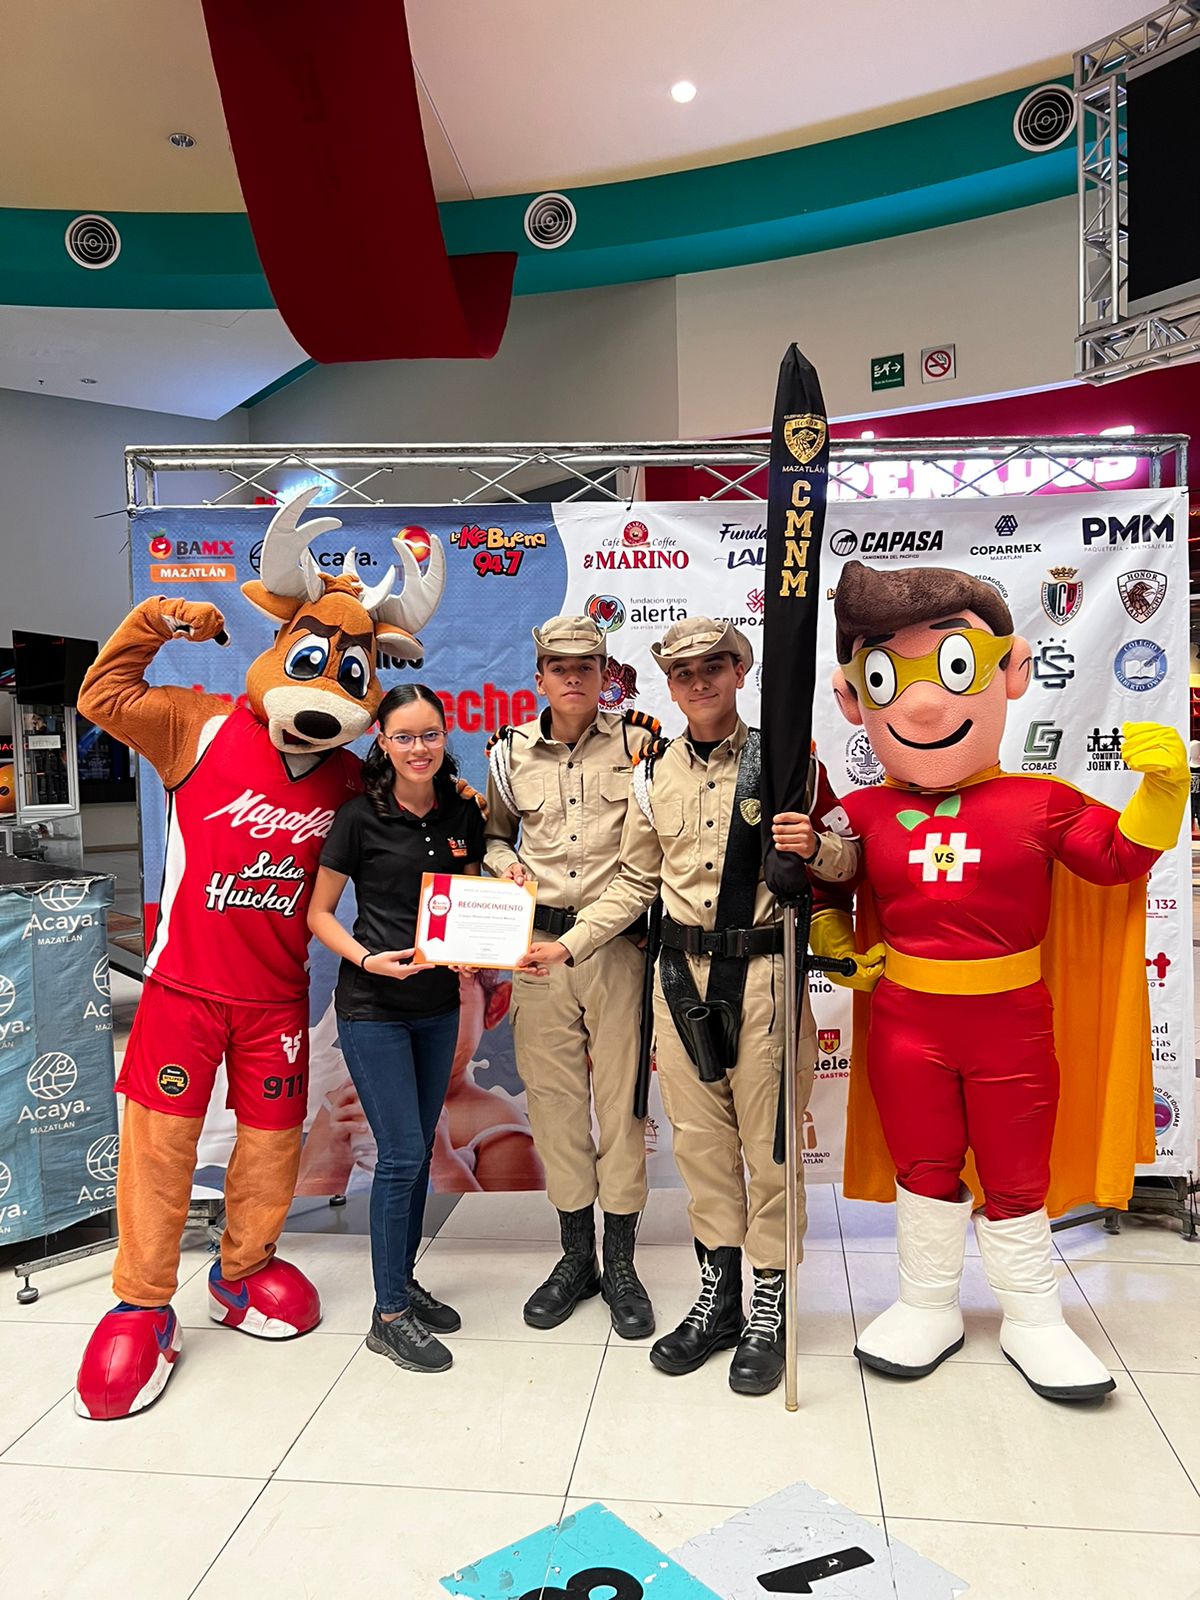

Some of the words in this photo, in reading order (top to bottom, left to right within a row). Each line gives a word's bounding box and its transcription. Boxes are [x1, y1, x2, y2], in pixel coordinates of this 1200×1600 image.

[781, 464, 825, 473] MAZATLÁN
[719, 523, 768, 543] Funda
[1082, 513, 1175, 546] PMM
[176, 540, 235, 556] BAMX
[652, 537, 677, 548] Coffee
[860, 530, 944, 553] CAPASA
[970, 543, 1042, 556] COPARMEX
[473, 550, 524, 577] 94.7
[596, 550, 689, 570] MARINO
[727, 546, 767, 570] LAL
[160, 566, 226, 578] MAZATLÁN
[1127, 571, 1158, 580] HONOR
[630, 605, 688, 623] alerta
[435, 683, 538, 733] eche
[1092, 752, 1124, 760] COMUNID
[1021, 762, 1057, 771] COBAES
[1086, 761, 1111, 771] JOHN
[1114, 761, 1121, 770] F.
[203, 789, 335, 844] Mazatla
[205, 872, 305, 917] Huichol
[458, 900, 523, 912] RECONOCIMIENTO
[30, 914, 99, 934] Acaya.
[808, 981, 836, 993] nio.
[83, 1001, 112, 1019] Ac
[0, 1019, 31, 1040] ya.
[820, 1071, 849, 1079] GASTRO
[263, 1073, 304, 1100] 911
[17, 1099, 91, 1125] Acaya.
[0, 1202, 28, 1224] ya.
